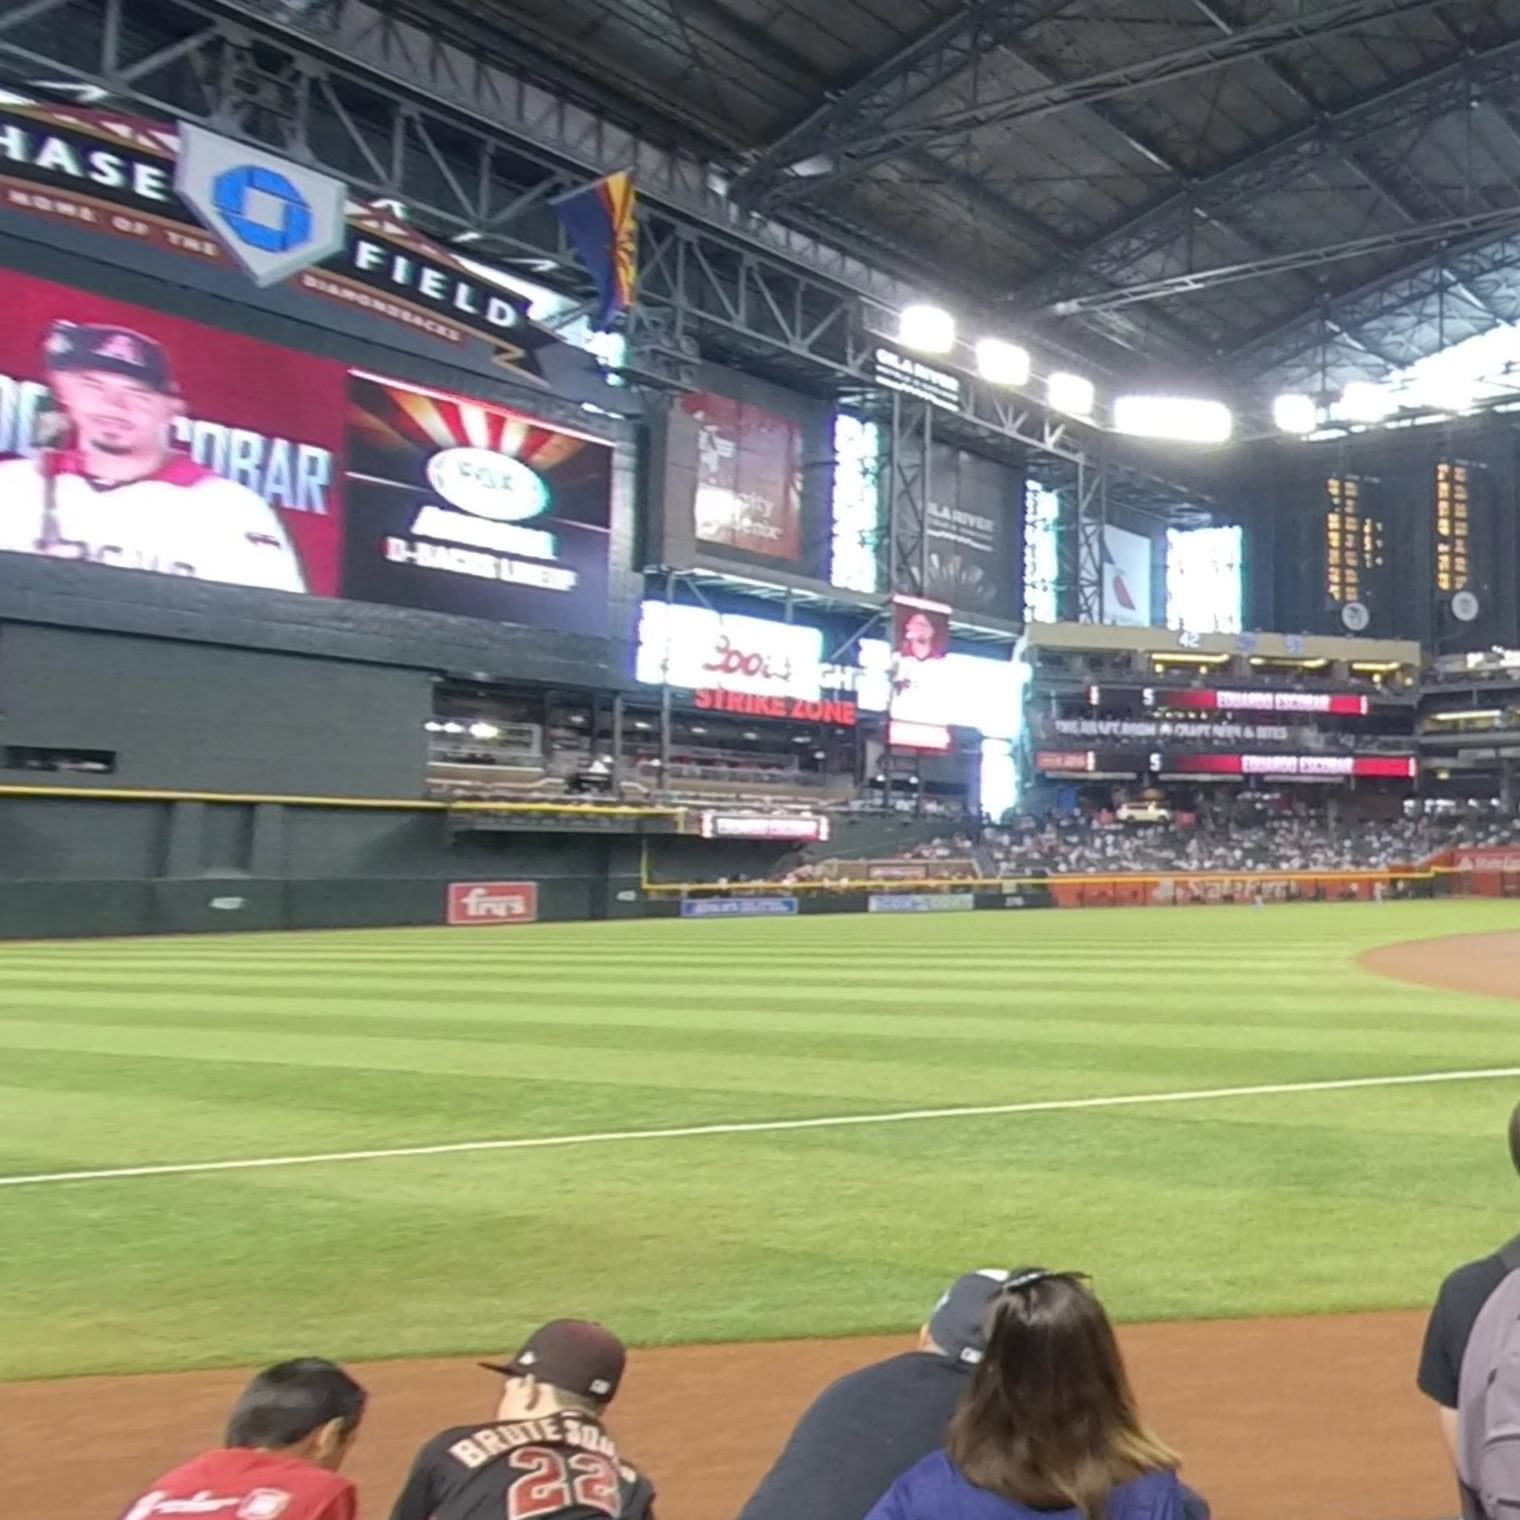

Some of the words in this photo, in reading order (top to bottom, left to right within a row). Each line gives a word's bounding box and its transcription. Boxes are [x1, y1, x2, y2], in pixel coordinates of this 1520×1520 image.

[8, 190, 97, 223] HOME
[111, 215, 149, 236] OF
[166, 230, 221, 257] THE
[302, 274, 460, 341] DIAMONDBACKS
[354, 241, 518, 328] FIELD
[1179, 632, 1200, 648] 42
[695, 688, 787, 717] STRIKE
[788, 696, 858, 727] ZONE
[450, 1417, 562, 1468] BRUTE
[508, 1445, 622, 1520] 22
